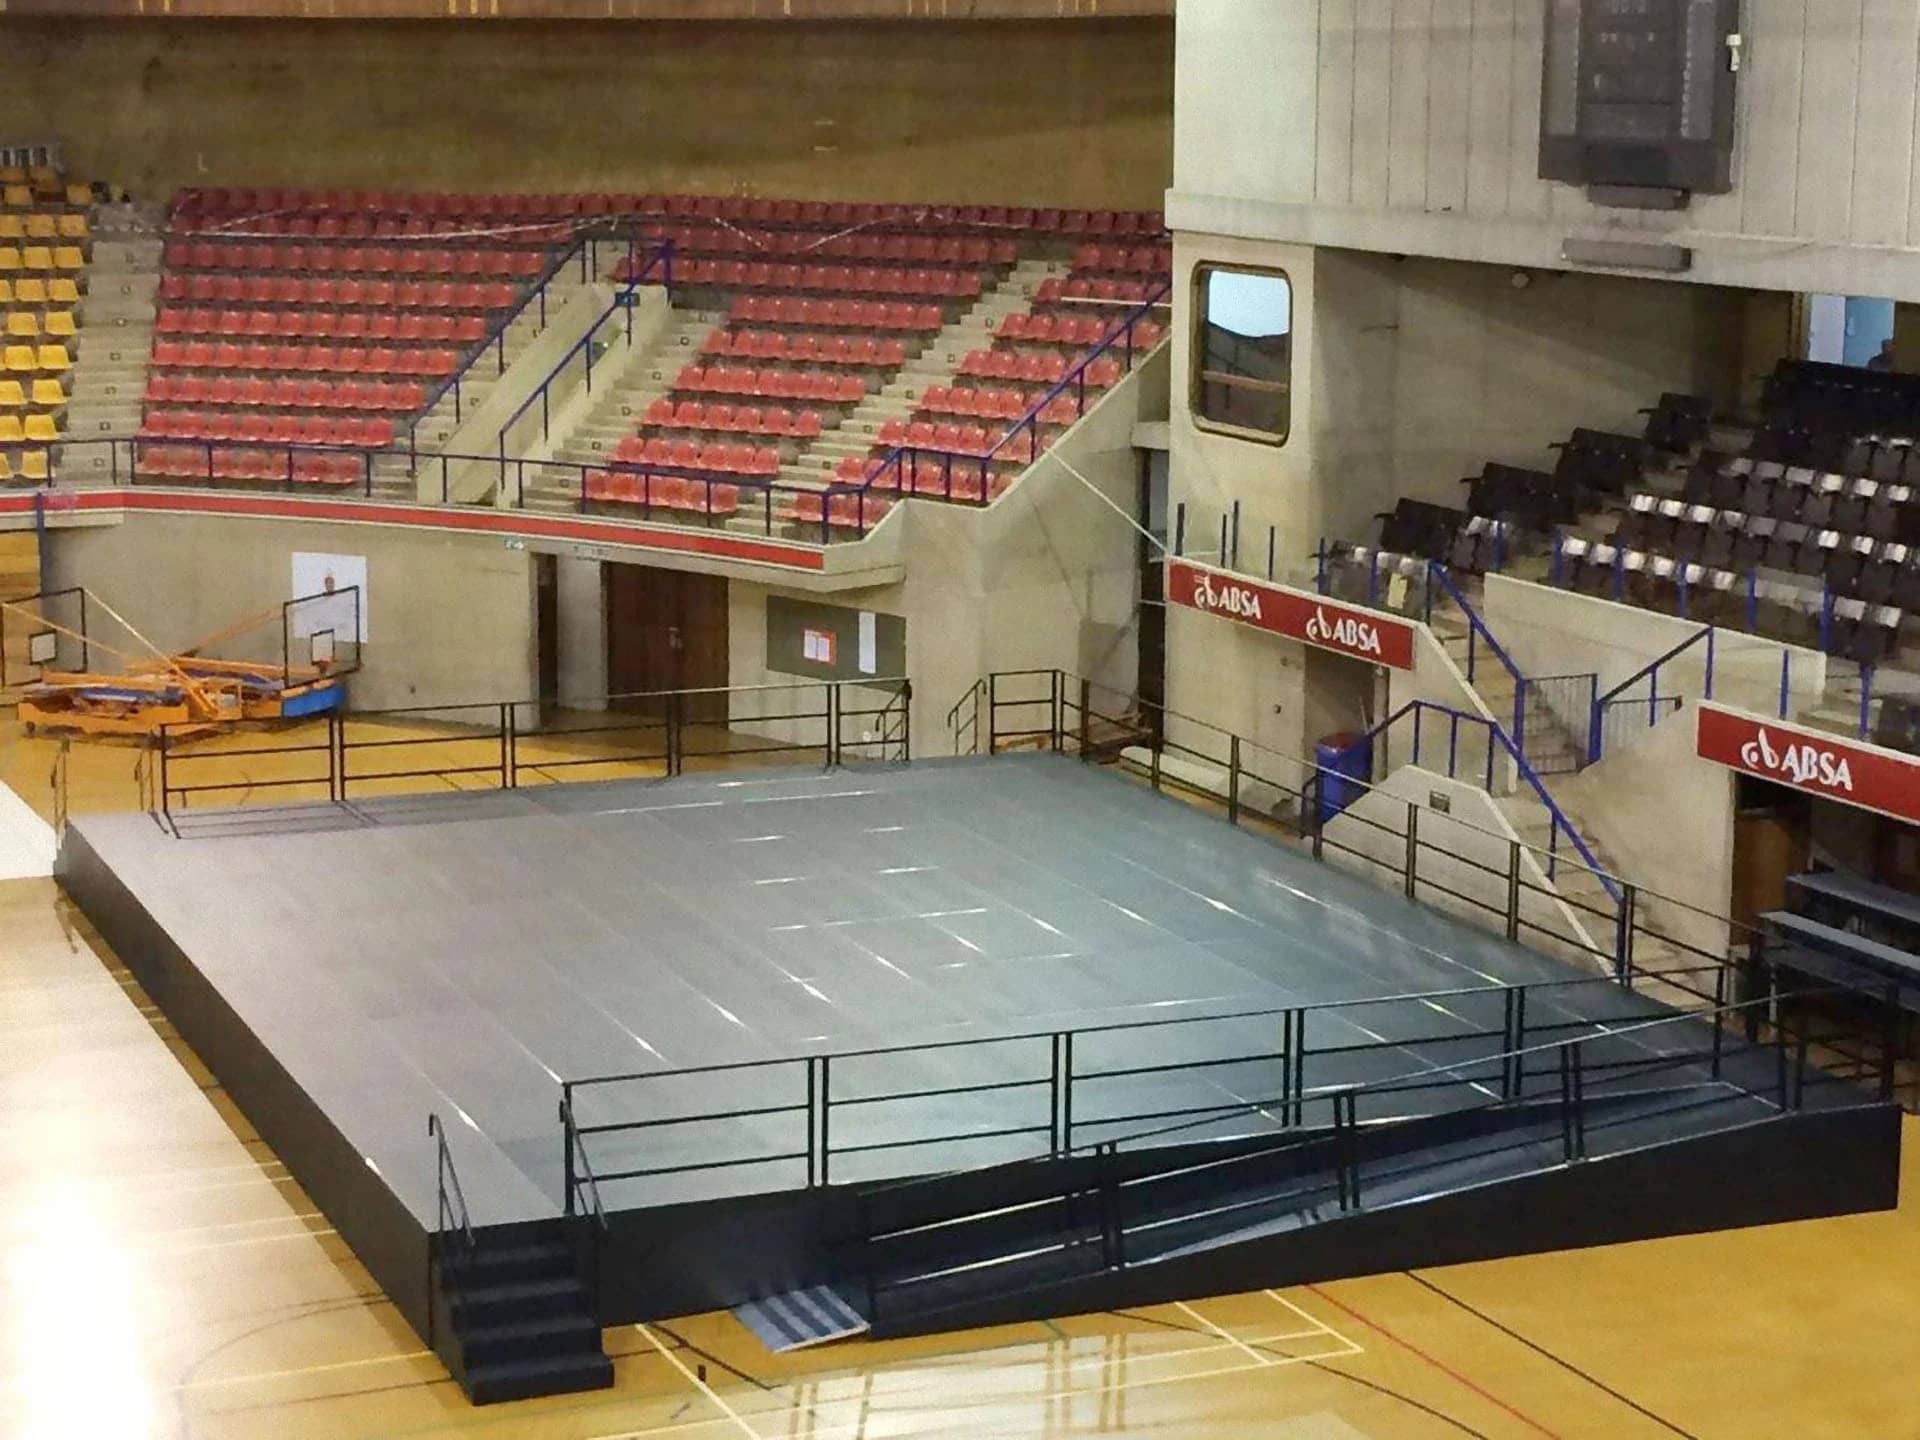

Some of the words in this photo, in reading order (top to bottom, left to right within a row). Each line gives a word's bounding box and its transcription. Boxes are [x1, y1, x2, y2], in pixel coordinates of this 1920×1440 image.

[1219, 585, 1261, 619] ABSA
[1333, 619, 1380, 654] ABSA
[1781, 744, 1852, 791] ABSA
